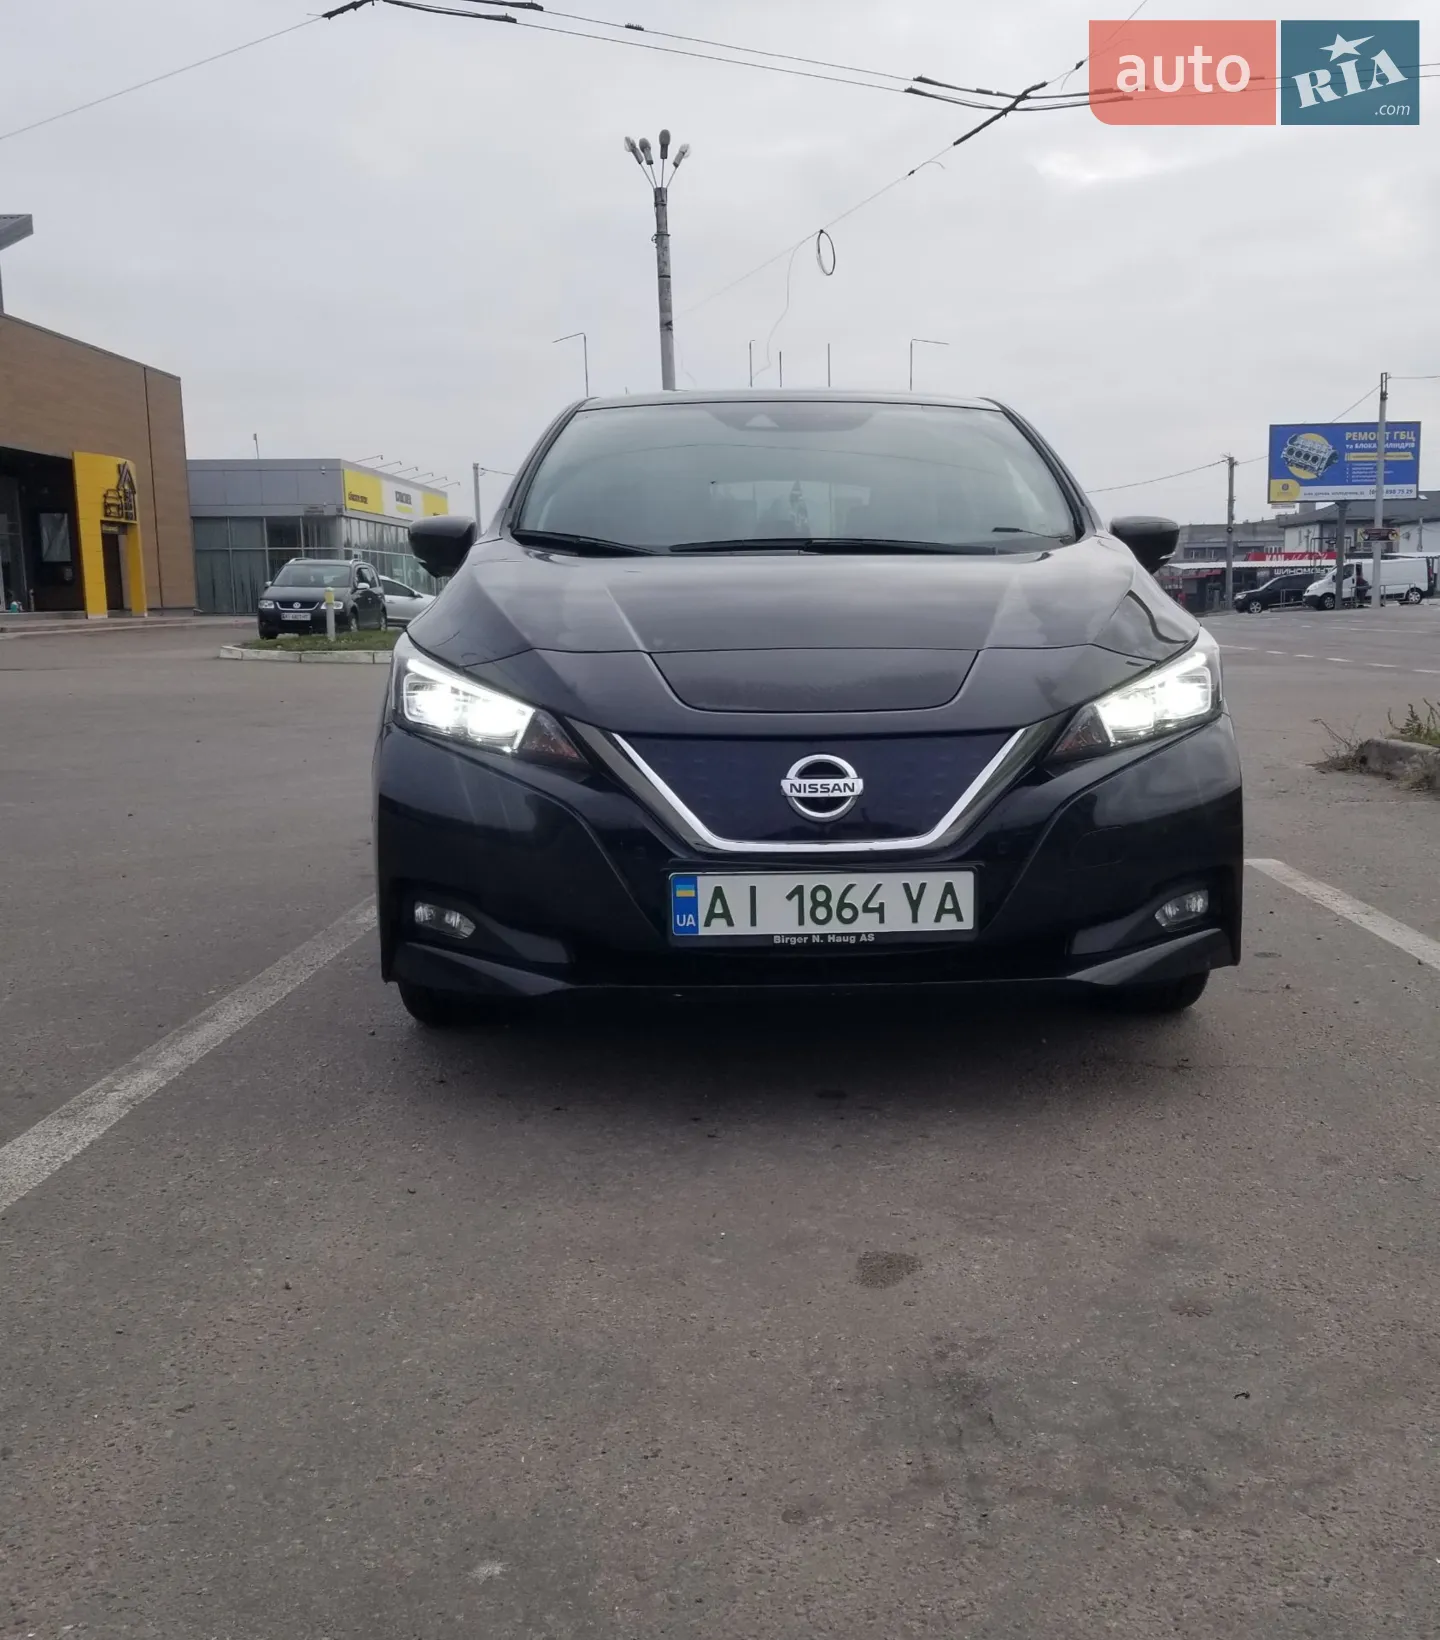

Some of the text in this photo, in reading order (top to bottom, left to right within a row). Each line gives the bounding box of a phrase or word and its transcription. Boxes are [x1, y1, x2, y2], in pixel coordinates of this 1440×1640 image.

[1345, 431, 1390, 441] РЕМОТ
[789, 782, 855, 794] NISSAN
[703, 881, 964, 928] AI 1864 YA
[676, 914, 696, 927] UA
[773, 934, 875, 945] Birger N. Haug AS
